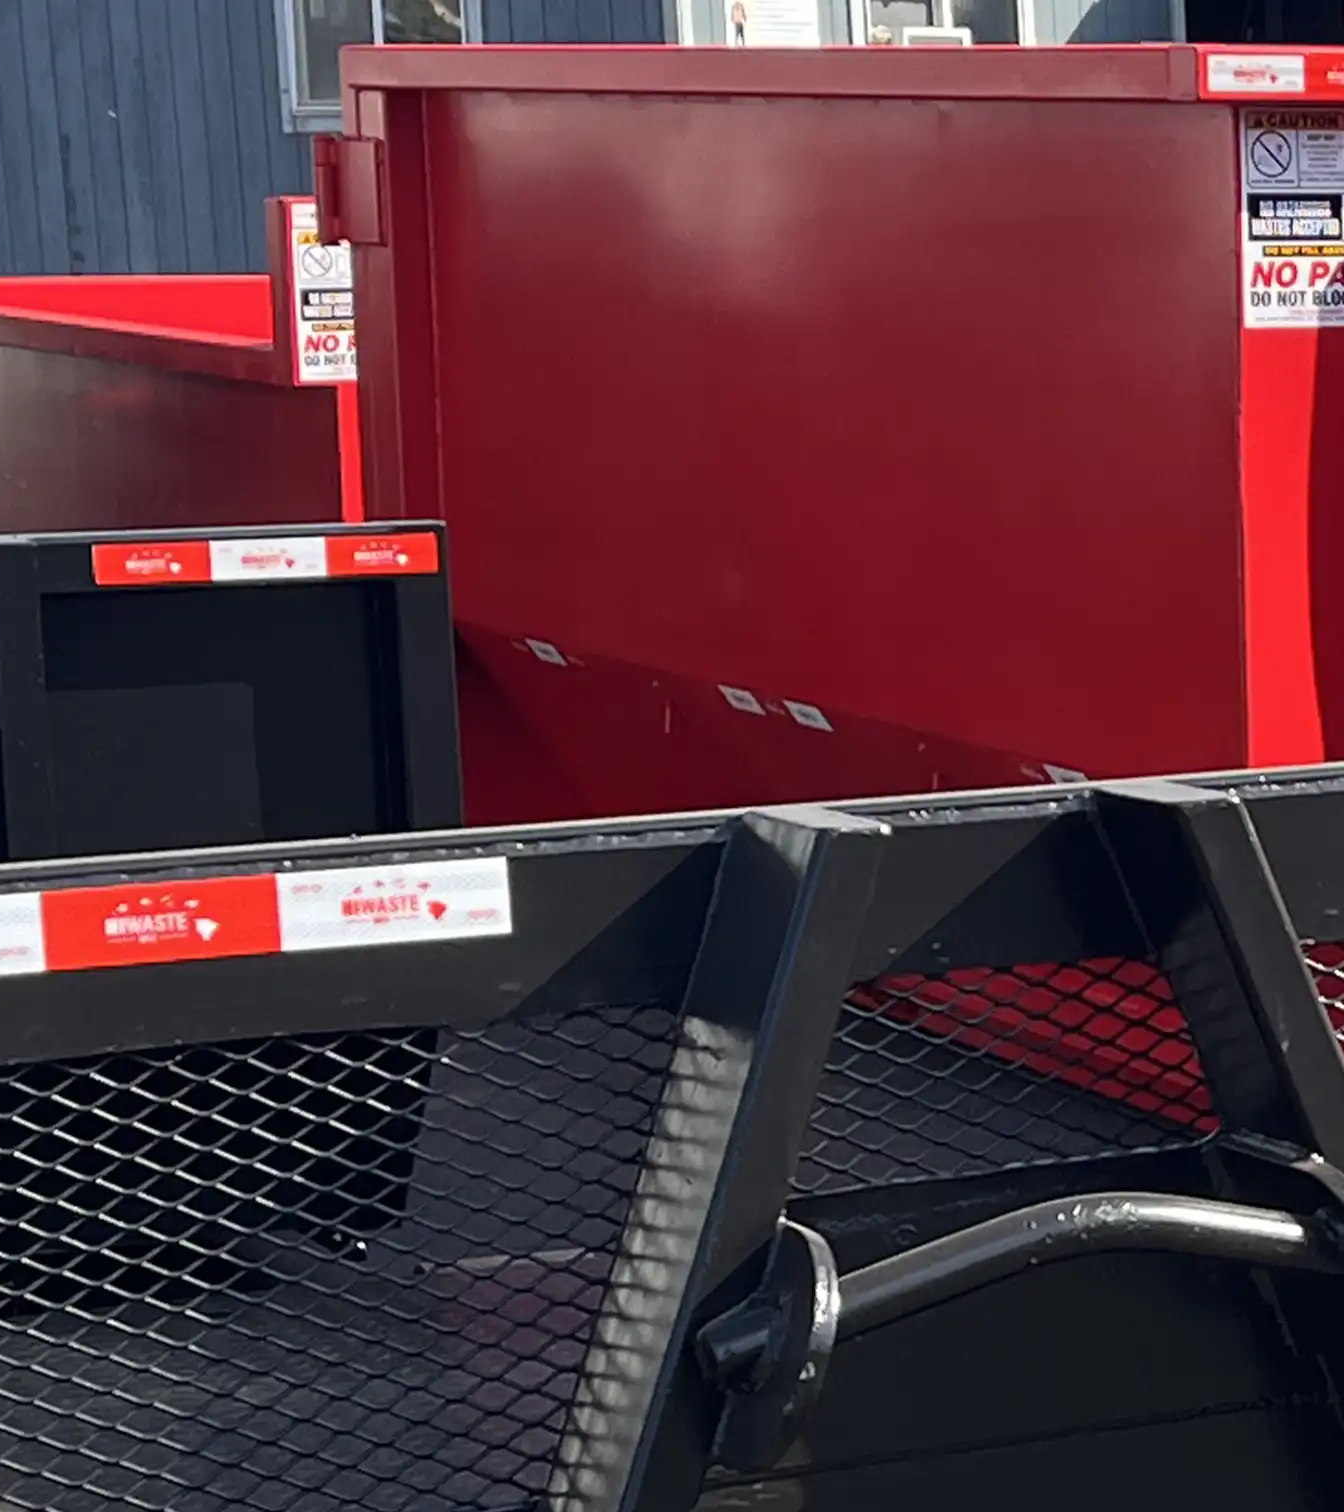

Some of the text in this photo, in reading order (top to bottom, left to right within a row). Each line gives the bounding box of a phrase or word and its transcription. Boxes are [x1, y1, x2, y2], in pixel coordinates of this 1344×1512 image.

[1251, 260, 1298, 288] NO
[1250, 290, 1271, 307] DO
[1278, 290, 1307, 306] NOT
[304, 335, 339, 352] NO
